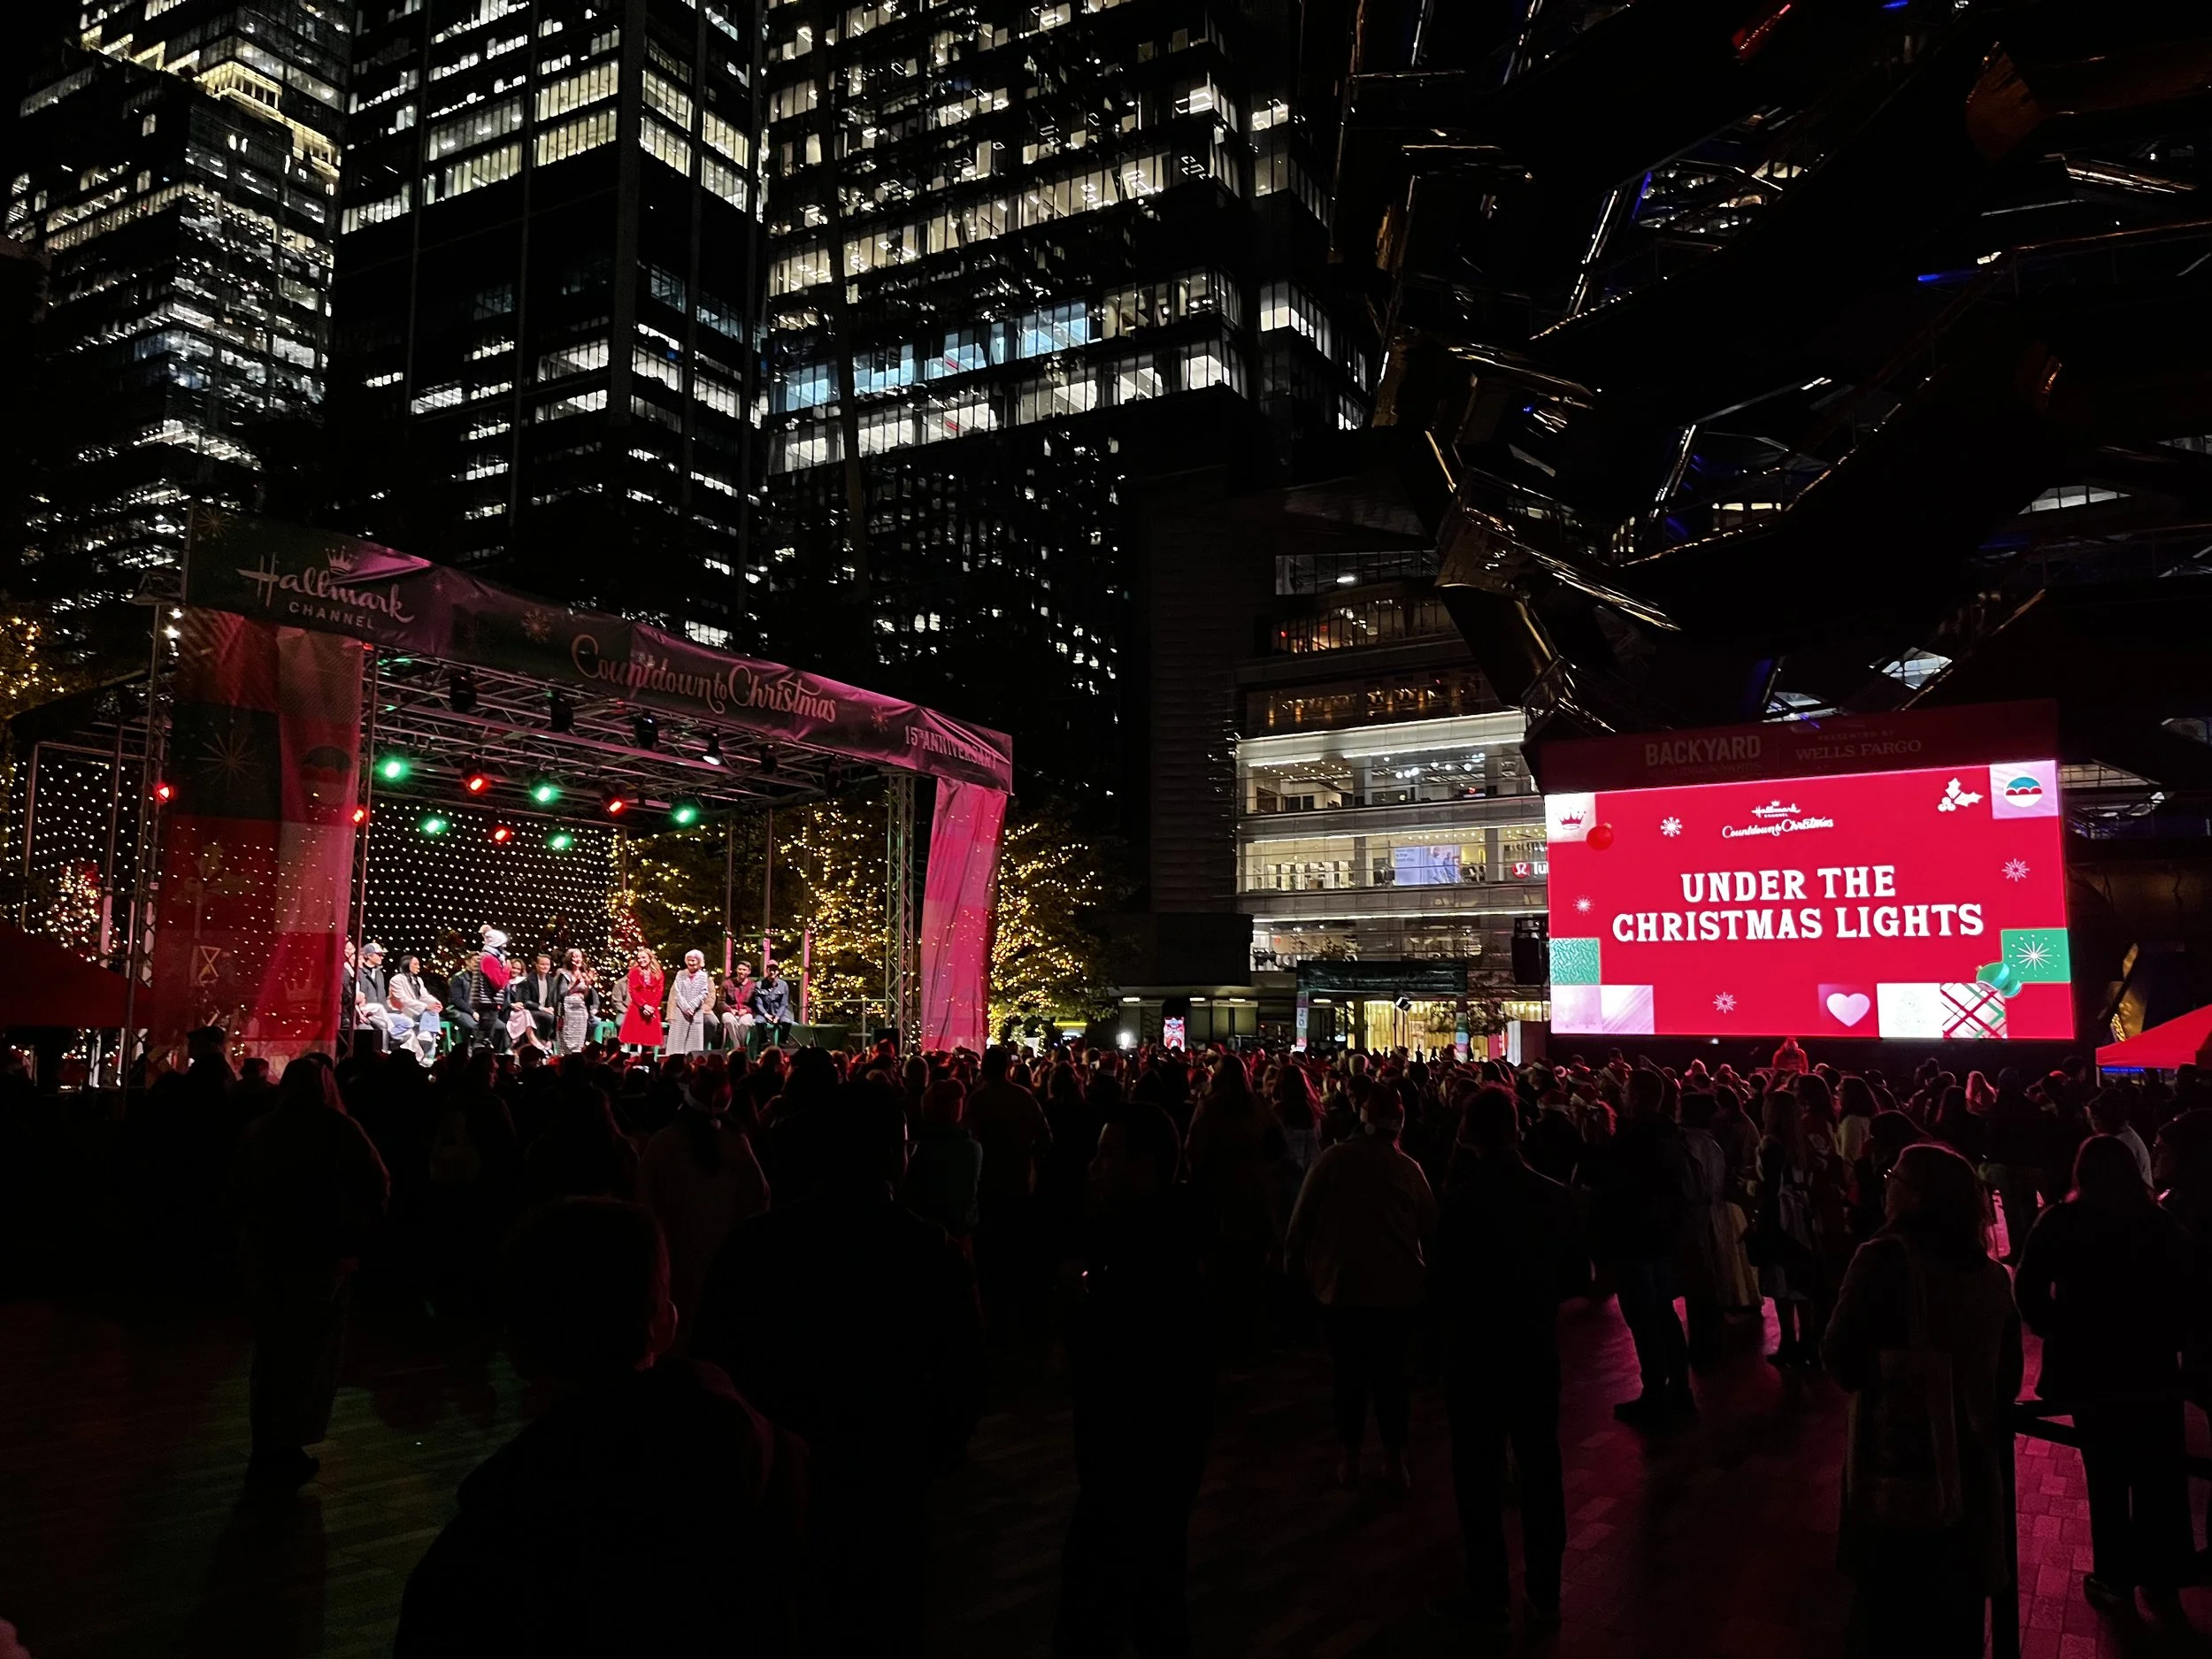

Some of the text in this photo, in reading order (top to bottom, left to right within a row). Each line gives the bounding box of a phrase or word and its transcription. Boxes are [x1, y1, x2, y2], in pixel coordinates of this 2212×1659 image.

[235, 551, 416, 624] Hallmark
[288, 601, 375, 630] CHANNEL
[571, 634, 837, 723] Countdown to Christmas
[1645, 735, 1763, 767] BACKYARD
[1795, 740, 1923, 762] WELLS FARGO
[1751, 803, 1801, 818] Hallmark
[1681, 865, 1895, 902] UNDER THE
[1612, 903, 1984, 941] CHRISTMAS LIGHTS
